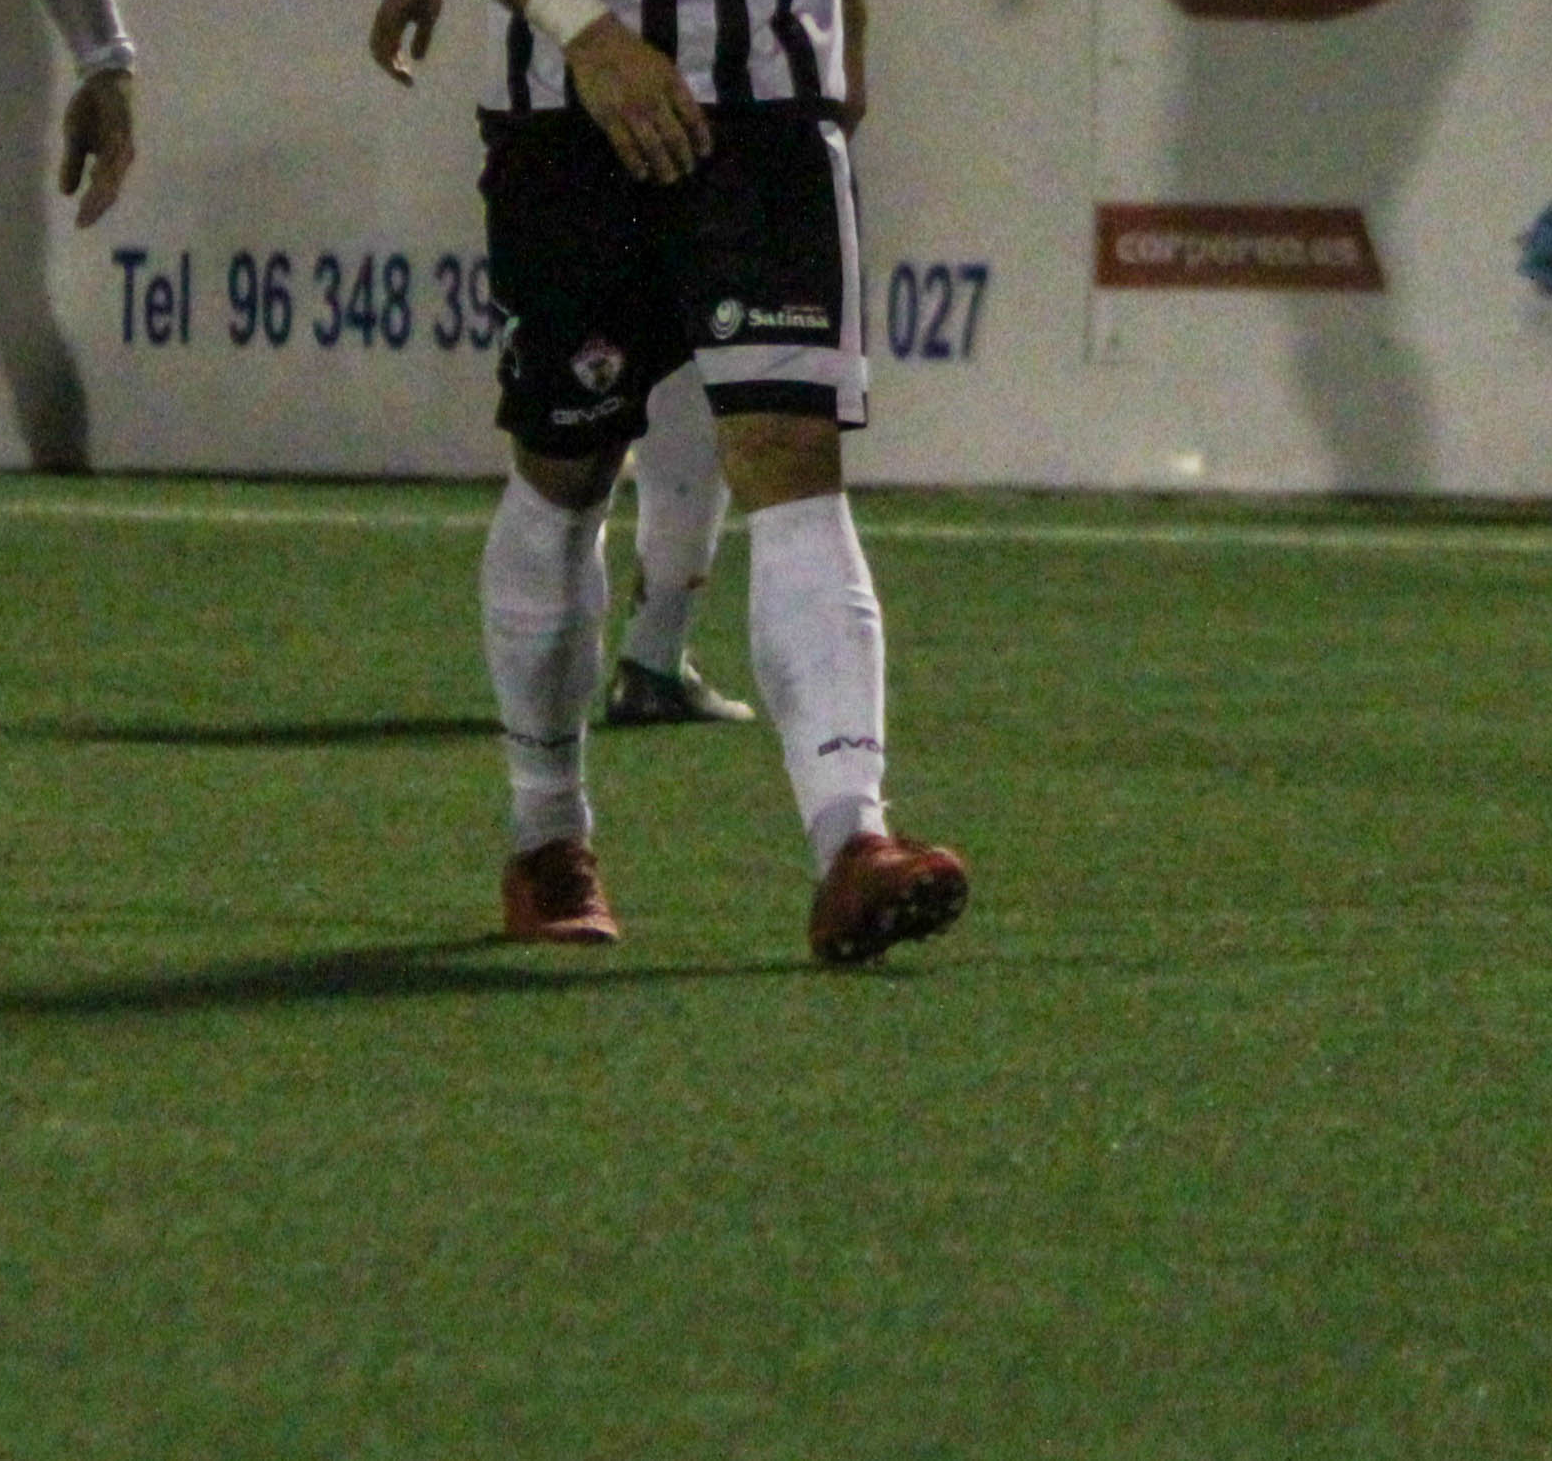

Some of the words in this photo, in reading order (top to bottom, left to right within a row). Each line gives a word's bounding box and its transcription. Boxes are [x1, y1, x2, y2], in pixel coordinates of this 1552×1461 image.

[113, 250, 190, 345] Tel
[229, 252, 292, 347] 96
[313, 253, 412, 349] 348
[887, 263, 989, 360] 027
